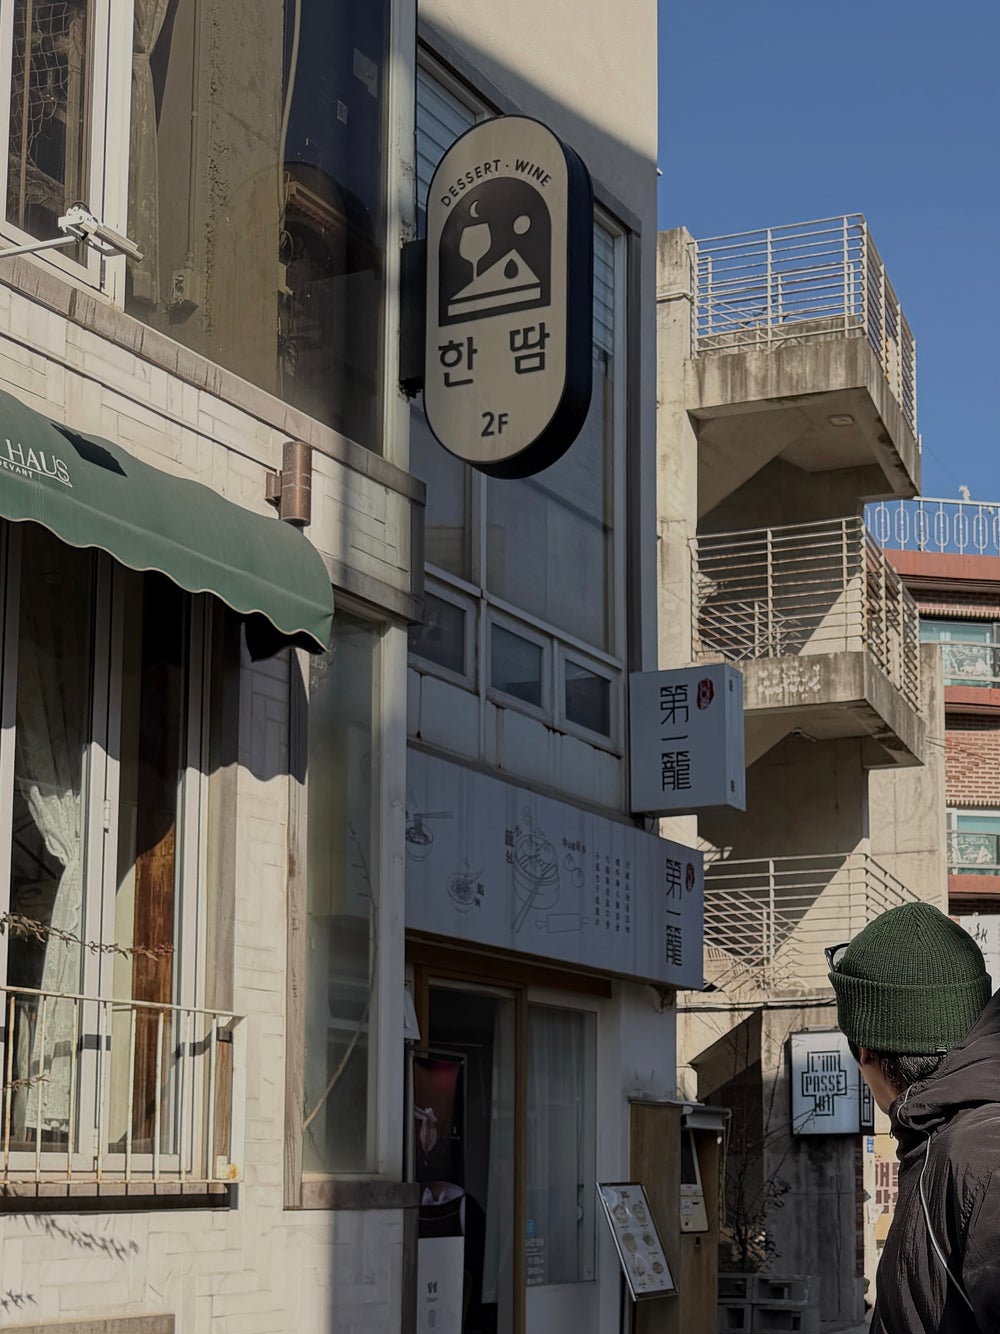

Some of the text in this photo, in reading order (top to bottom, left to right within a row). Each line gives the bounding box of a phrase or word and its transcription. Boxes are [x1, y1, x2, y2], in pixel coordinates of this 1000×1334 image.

[440, 158, 552, 207] DESSERT WINE
[438, 322, 550, 388] 한 땀
[480, 411, 509, 437] 2F
[5, 439, 70, 482] HAUS
[660, 684, 692, 792] 第一籠
[805, 1075, 843, 1093] PASSE
